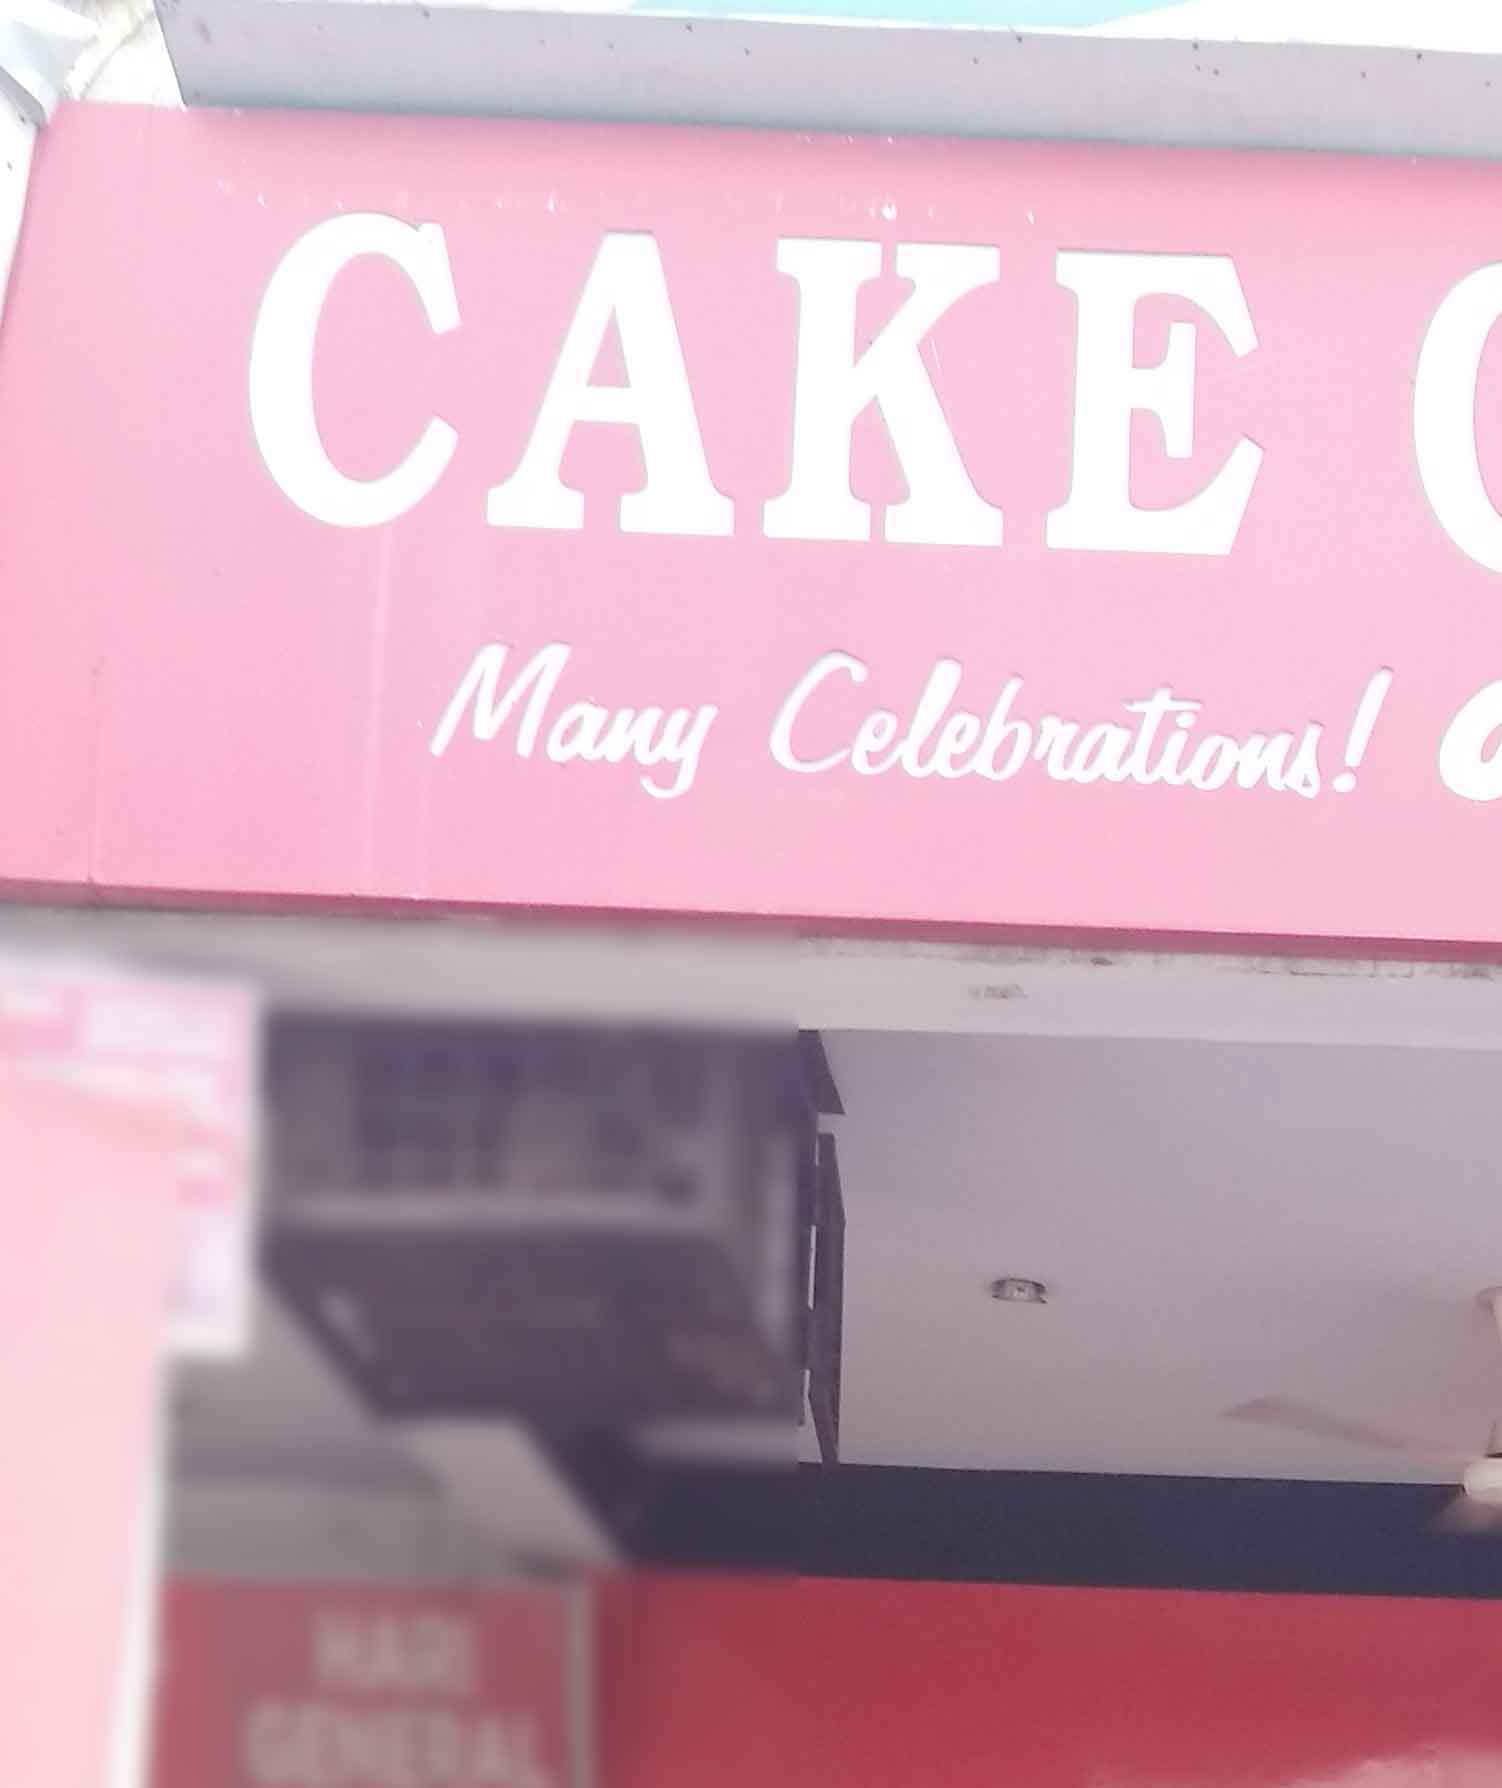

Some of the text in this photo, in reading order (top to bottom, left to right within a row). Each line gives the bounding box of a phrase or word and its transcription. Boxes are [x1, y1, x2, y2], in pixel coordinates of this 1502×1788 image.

[247, 212, 1264, 555] CAKE
[430, 642, 718, 798] Many
[769, 650, 1392, 800] Celebrations!
